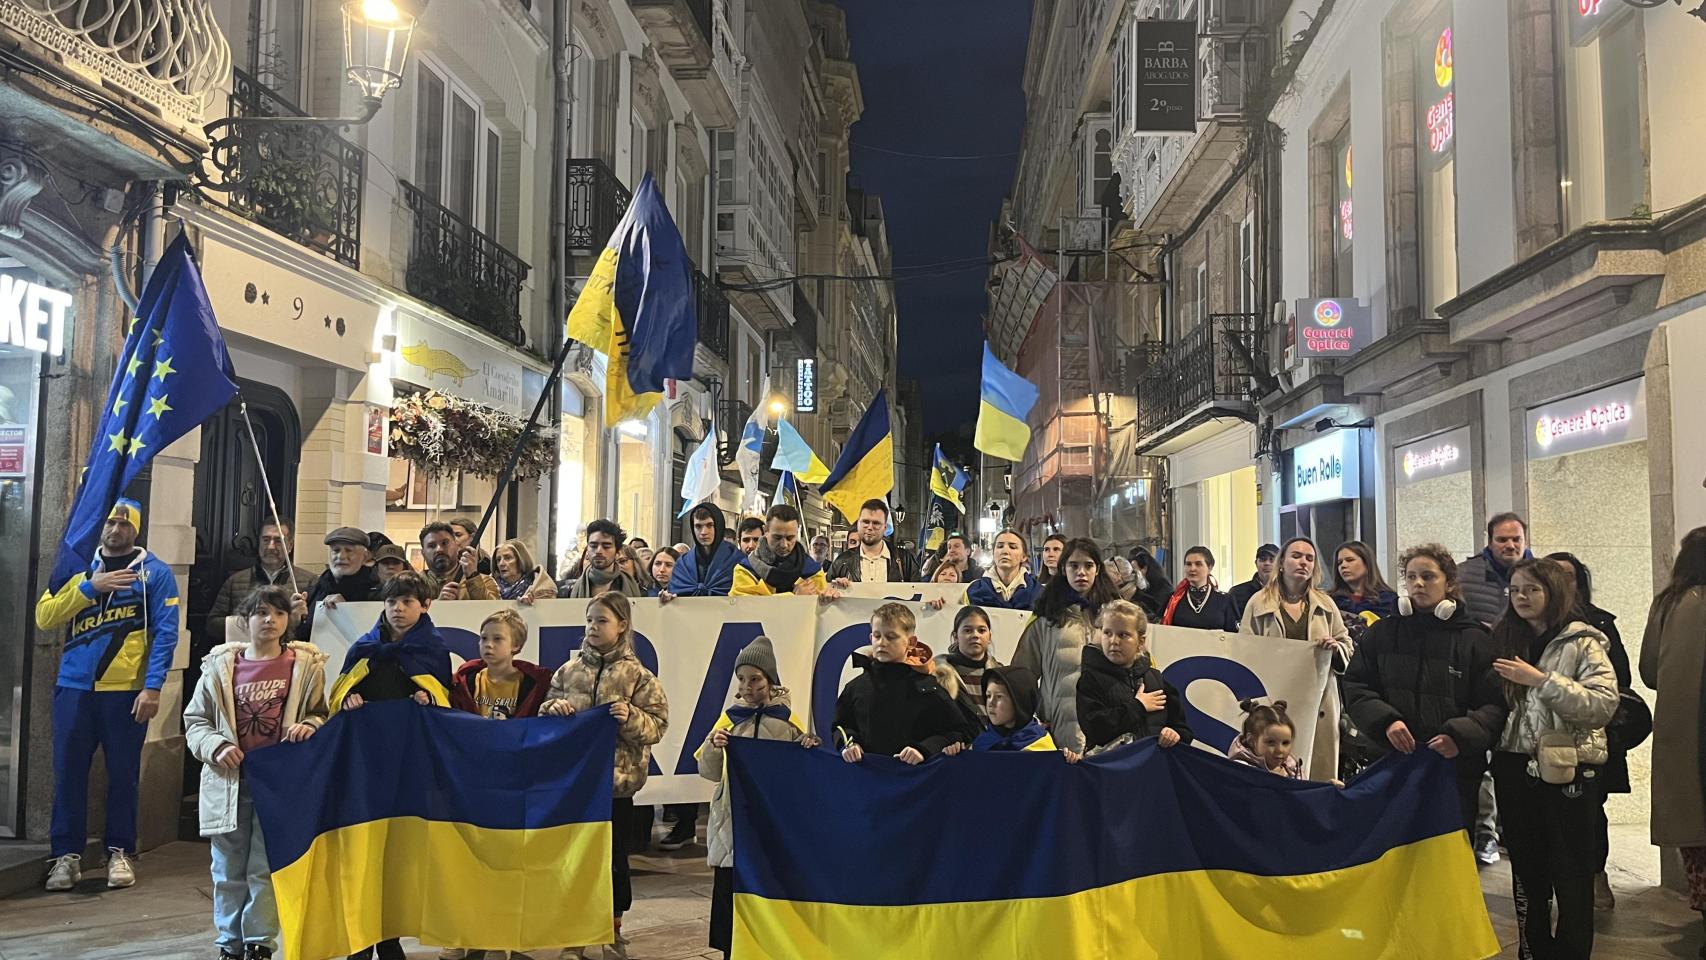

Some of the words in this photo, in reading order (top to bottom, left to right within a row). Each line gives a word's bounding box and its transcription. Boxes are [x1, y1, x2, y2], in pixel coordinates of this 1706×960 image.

[1144, 57, 1188, 69] BARBA
[1144, 71, 1190, 80] ABOGADOS
[292, 297, 304, 320] 9
[1303, 326, 1353, 338] General
[1307, 339, 1350, 352] Optica
[803, 359, 813, 406] TATTOO
[1551, 409, 1591, 438] General
[1591, 402, 1631, 434] Optica
[1297, 465, 1318, 488] Buen
[74, 605, 137, 634] KRAINE
[235, 679, 287, 695] TTITUDE
[250, 689, 278, 701] LOVE
